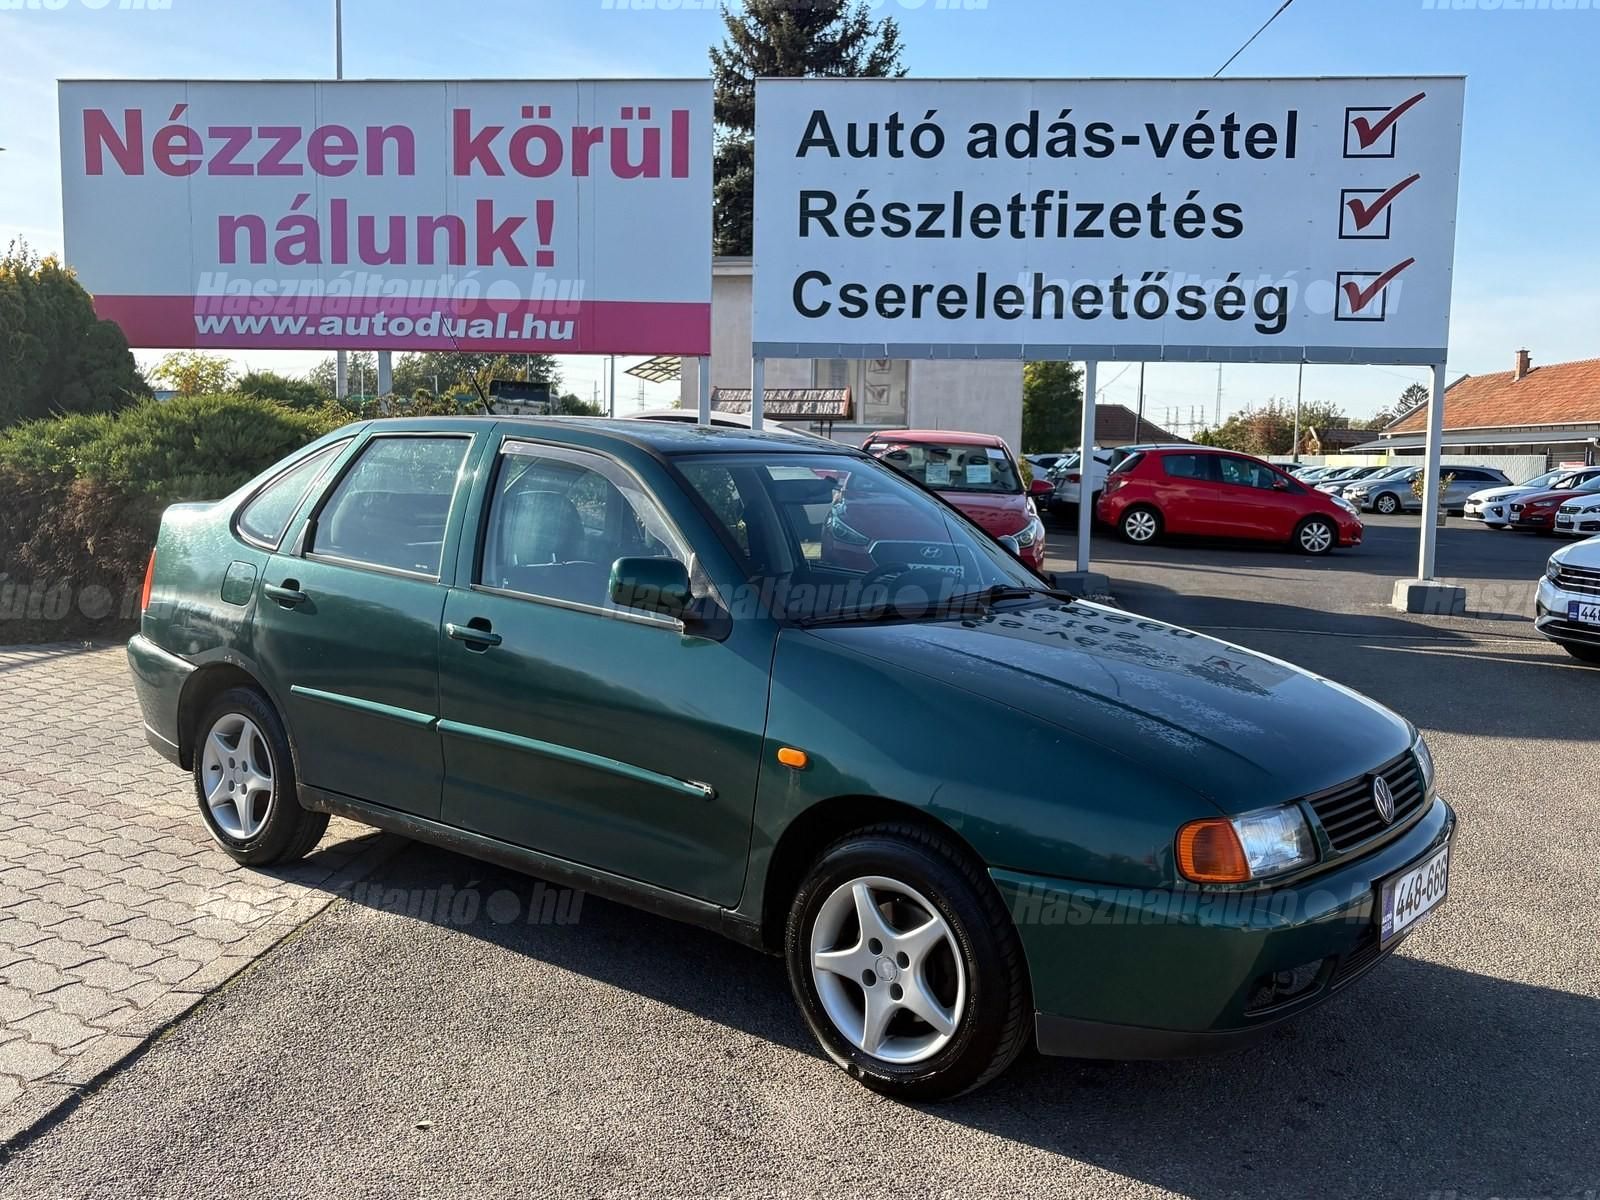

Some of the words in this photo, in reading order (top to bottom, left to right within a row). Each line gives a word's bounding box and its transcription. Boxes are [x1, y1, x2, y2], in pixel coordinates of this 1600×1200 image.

[83, 104, 416, 177] Nézzen
[453, 105, 691, 180] körül
[795, 108, 946, 160] Autó
[966, 107, 1299, 160] adás-vétel
[217, 193, 556, 268] nálunk!
[798, 187, 1245, 241] Részletfizetés
[194, 311, 575, 342] www.autodual.hu
[792, 270, 1290, 334] Cserelehetőség
[1395, 854, 1448, 924] 448-666
